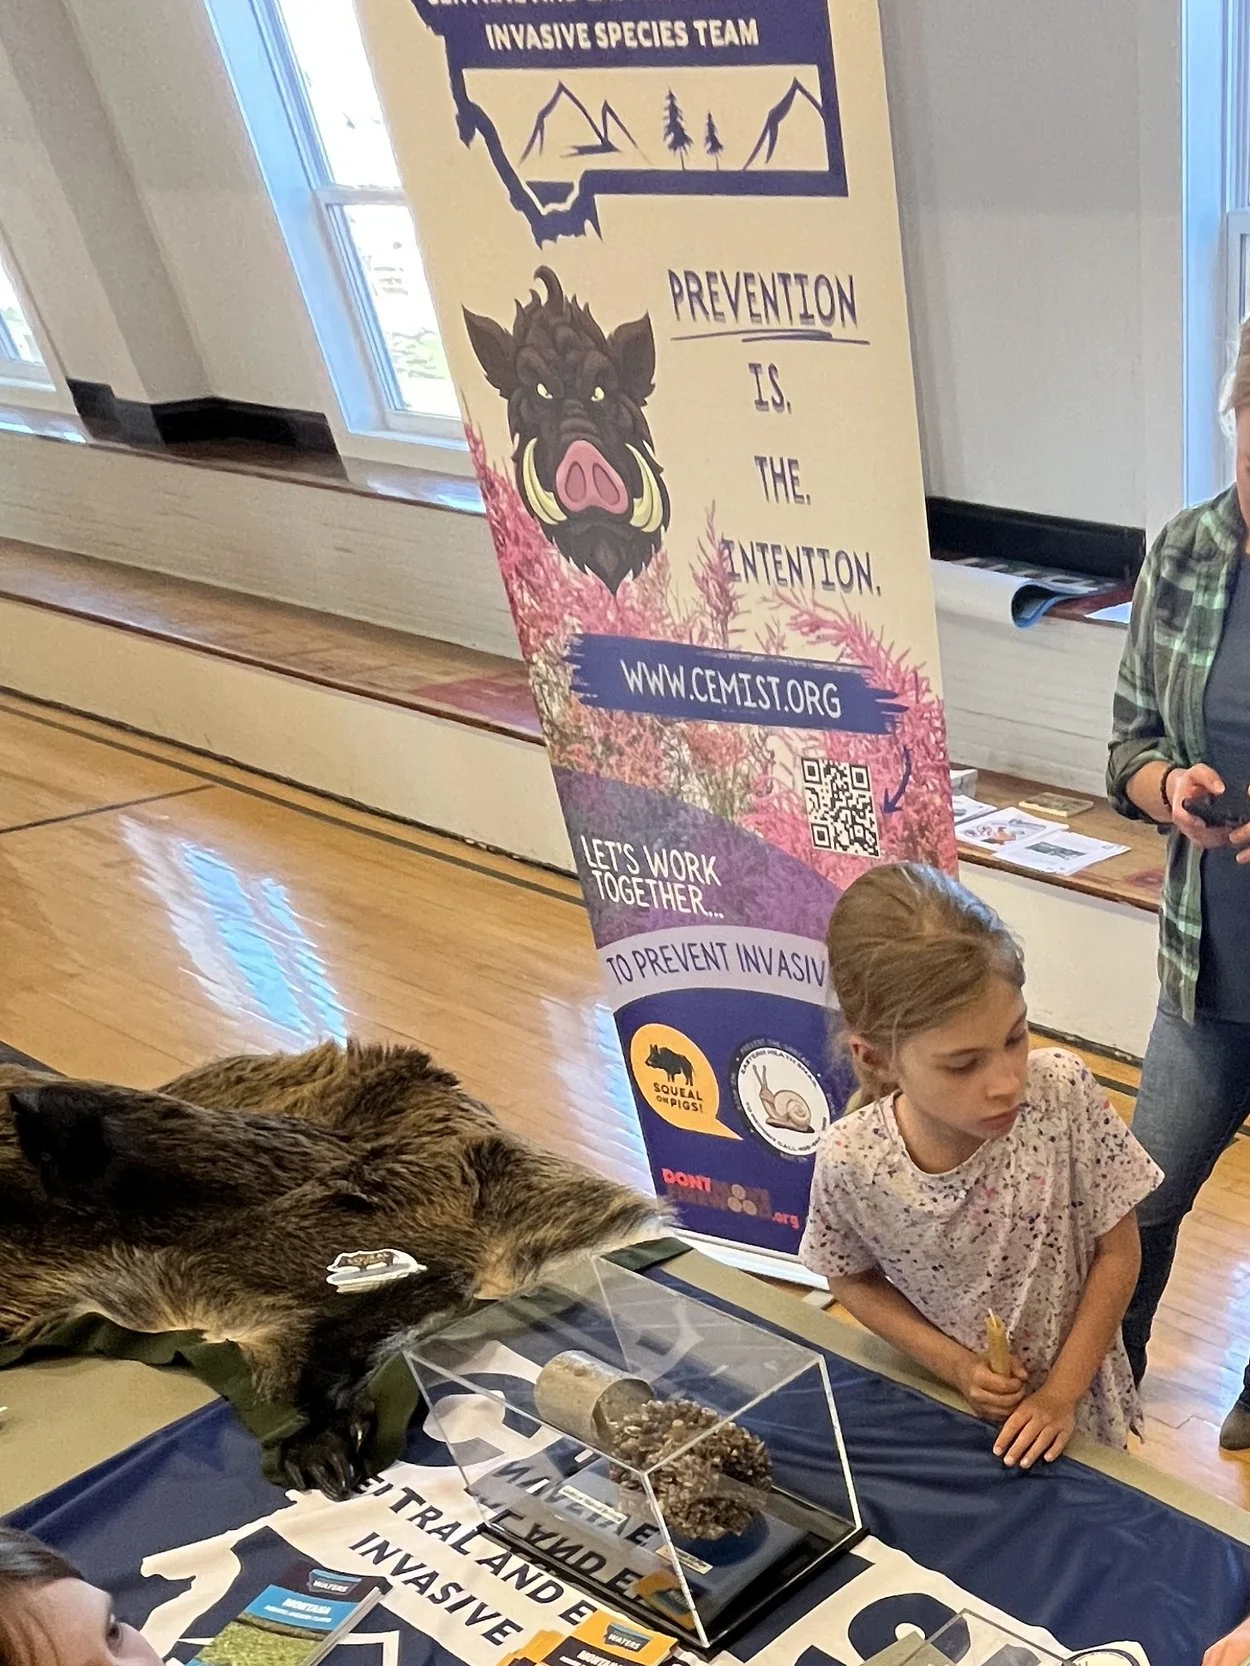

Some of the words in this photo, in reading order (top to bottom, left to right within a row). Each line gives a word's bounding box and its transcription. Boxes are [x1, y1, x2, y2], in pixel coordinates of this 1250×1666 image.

[485, 23, 592, 50] INVASIVE
[594, 20, 689, 49] SPECIES
[693, 18, 760, 47] TEAM
[667, 269, 858, 327] PREVENTION
[748, 362, 792, 414] IS.
[754, 455, 811, 506] THE.
[724, 539, 882, 595] INTENTION.
[620, 658, 843, 720] WWW.CEMIST.ORG
[581, 834, 639, 876] LET'S
[643, 844, 722, 888] WORK
[592, 868, 725, 919] TOGETHER...
[606, 956, 632, 985] TO
[636, 942, 732, 980] PREVENT
[736, 943, 826, 987] INVASIV
[653, 1082, 703, 1101] SQUEAL
[656, 1095, 669, 1104] ON
[670, 1098, 703, 1113] PIGS!
[661, 1167, 711, 1193] DONT
[772, 1211, 800, 1230] .org
[312, 1579, 351, 1593] WATERS
[348, 1531, 524, 1647] INVASIVE
[475, 1549, 565, 1605] AND
[608, 1633, 642, 1650] WATERS
